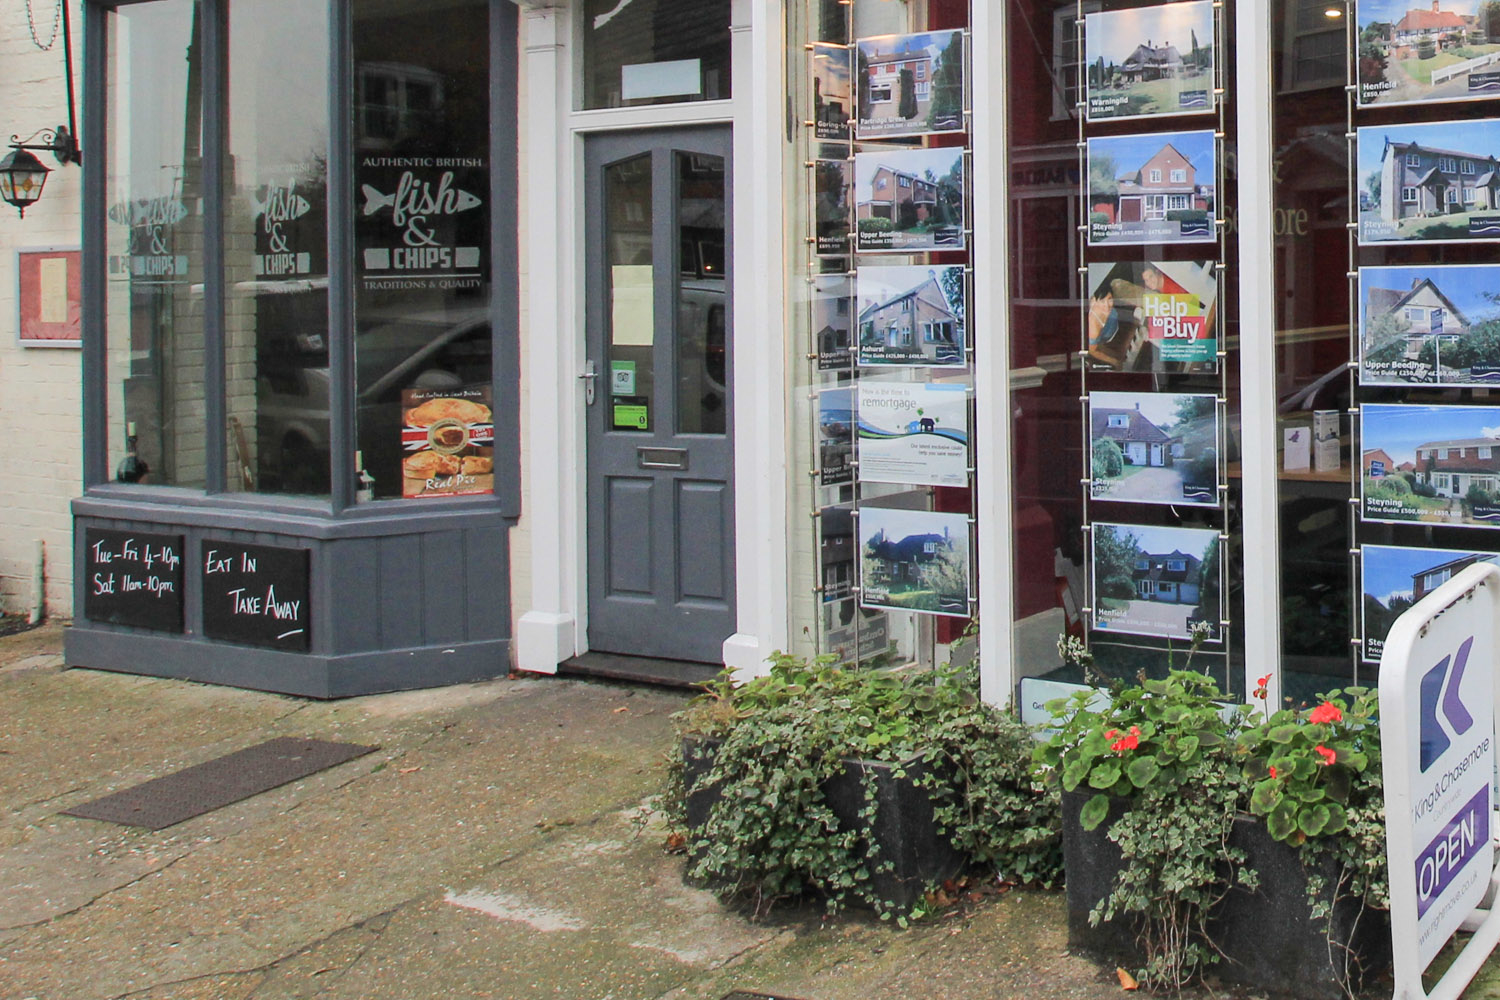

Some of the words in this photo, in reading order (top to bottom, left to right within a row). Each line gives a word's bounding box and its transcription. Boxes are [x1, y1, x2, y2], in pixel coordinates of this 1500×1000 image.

[1363, 81, 1397, 90] Henfield
[1091, 96, 1129, 106] Warninglid
[363, 157, 434, 167] AUTHENTIC
[436, 158, 482, 167] BRITISH
[265, 177, 299, 233] fish
[393, 171, 458, 227] fish
[403, 215, 442, 247] &
[1364, 220, 1399, 230] Steyning
[270, 222, 289, 253] &
[860, 231, 878, 239] Upper
[146, 255, 175, 275] CHIPS
[265, 254, 296, 275] CHIPS
[393, 247, 451, 269] CHIPS
[364, 280, 426, 290] TRADITIONS
[439, 279, 481, 289] QUALITY
[1145, 296, 1188, 323] Help
[1152, 316, 1163, 327] to
[1163, 317, 1199, 344] Buy
[1365, 361, 1390, 369] Upper
[1391, 361, 1425, 369] Beeding
[862, 398, 917, 410] remortgage
[426, 475, 452, 490] Real
[456, 474, 476, 486] Pie
[1367, 497, 1403, 507] Steyning
[94, 572, 115, 596] Sat
[1098, 608, 1127, 617] Henfield
[1420, 809, 1475, 902] OPEN
